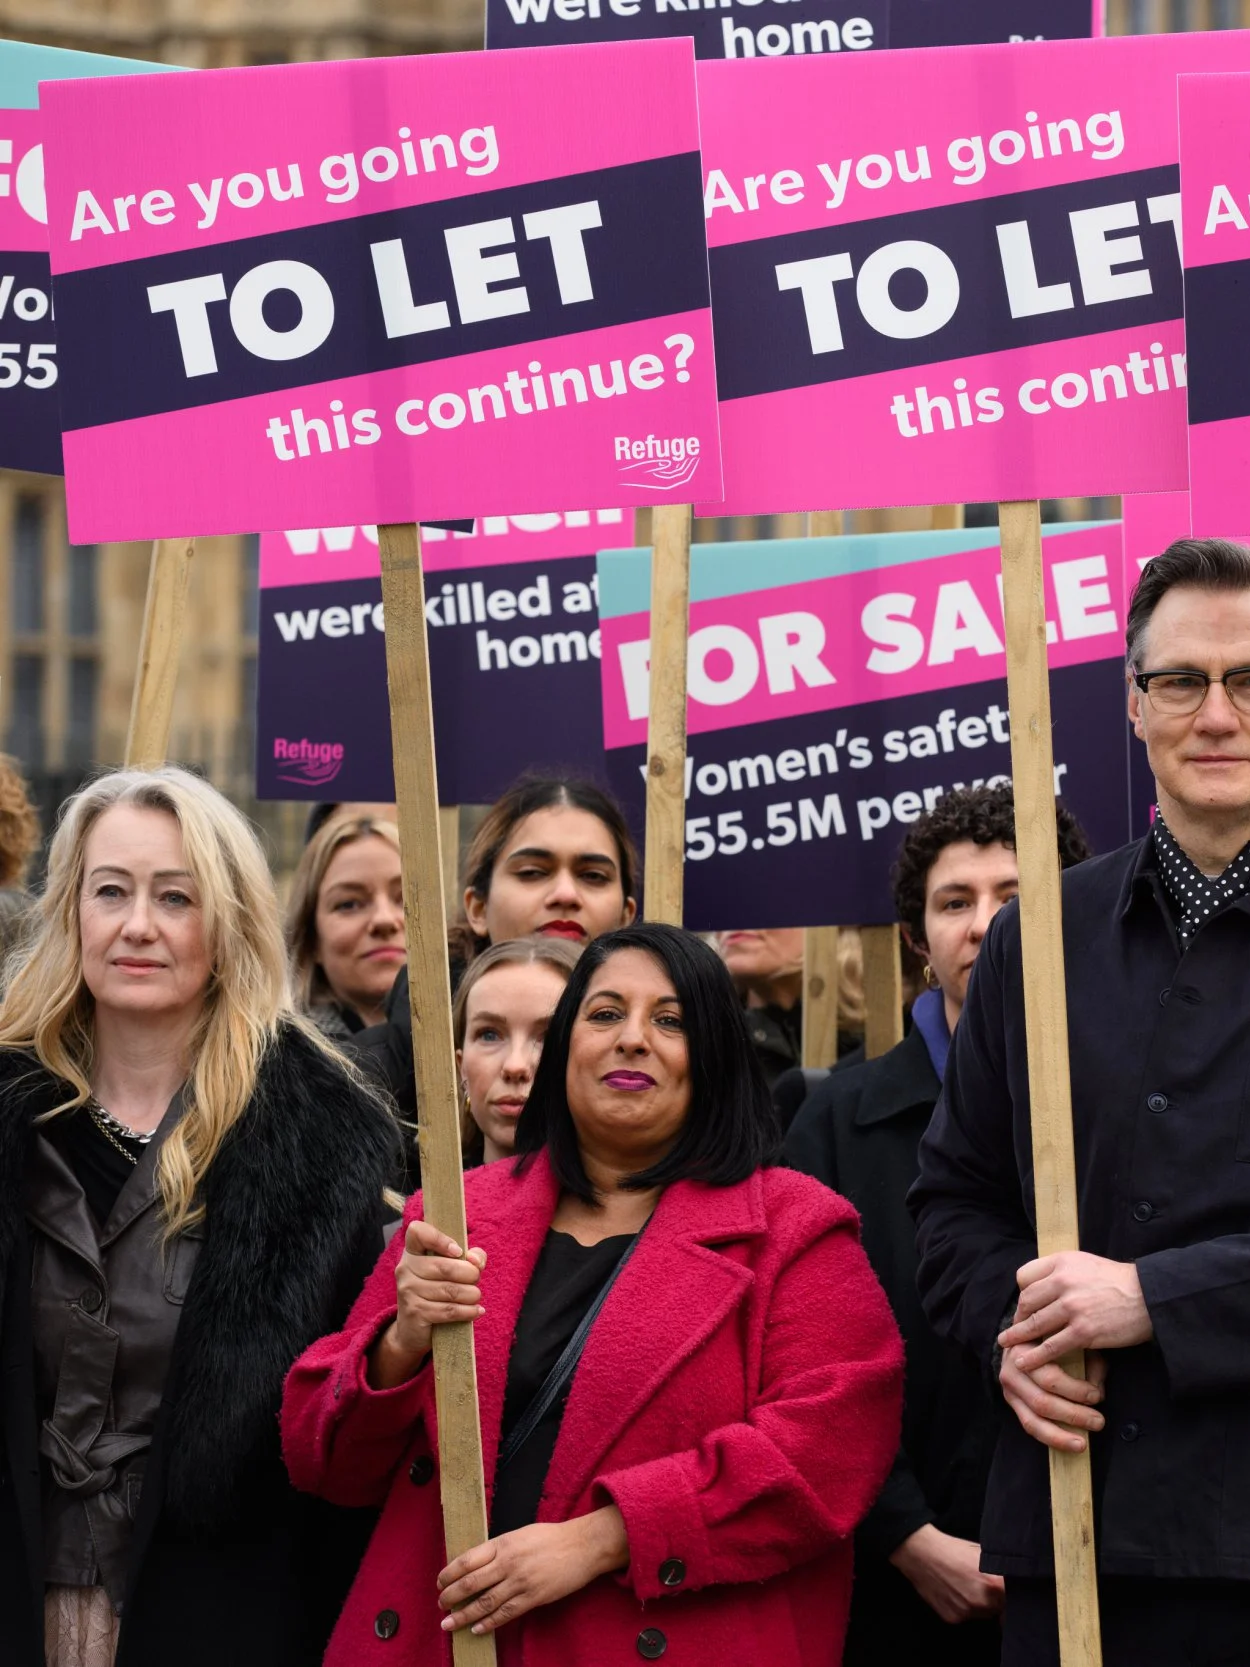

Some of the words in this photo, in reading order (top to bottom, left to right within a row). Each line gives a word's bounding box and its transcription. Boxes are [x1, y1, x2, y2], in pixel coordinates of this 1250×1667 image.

[721, 16, 874, 59] home
[69, 190, 176, 241] Are
[189, 161, 304, 229] you
[319, 125, 500, 203] going
[703, 169, 805, 219] Are
[817, 146, 931, 209] you
[947, 110, 1125, 185] going
[146, 259, 335, 378] TO
[370, 200, 603, 339] LET
[775, 240, 960, 355] TO
[266, 401, 381, 462] this
[394, 334, 696, 437] continue?
[890, 378, 1004, 438] this
[614, 435, 700, 462] Refuge
[861, 555, 1118, 674] SAE
[274, 738, 344, 760] Refuge
[884, 704, 1011, 764] safet
[857, 786, 940, 841] per
